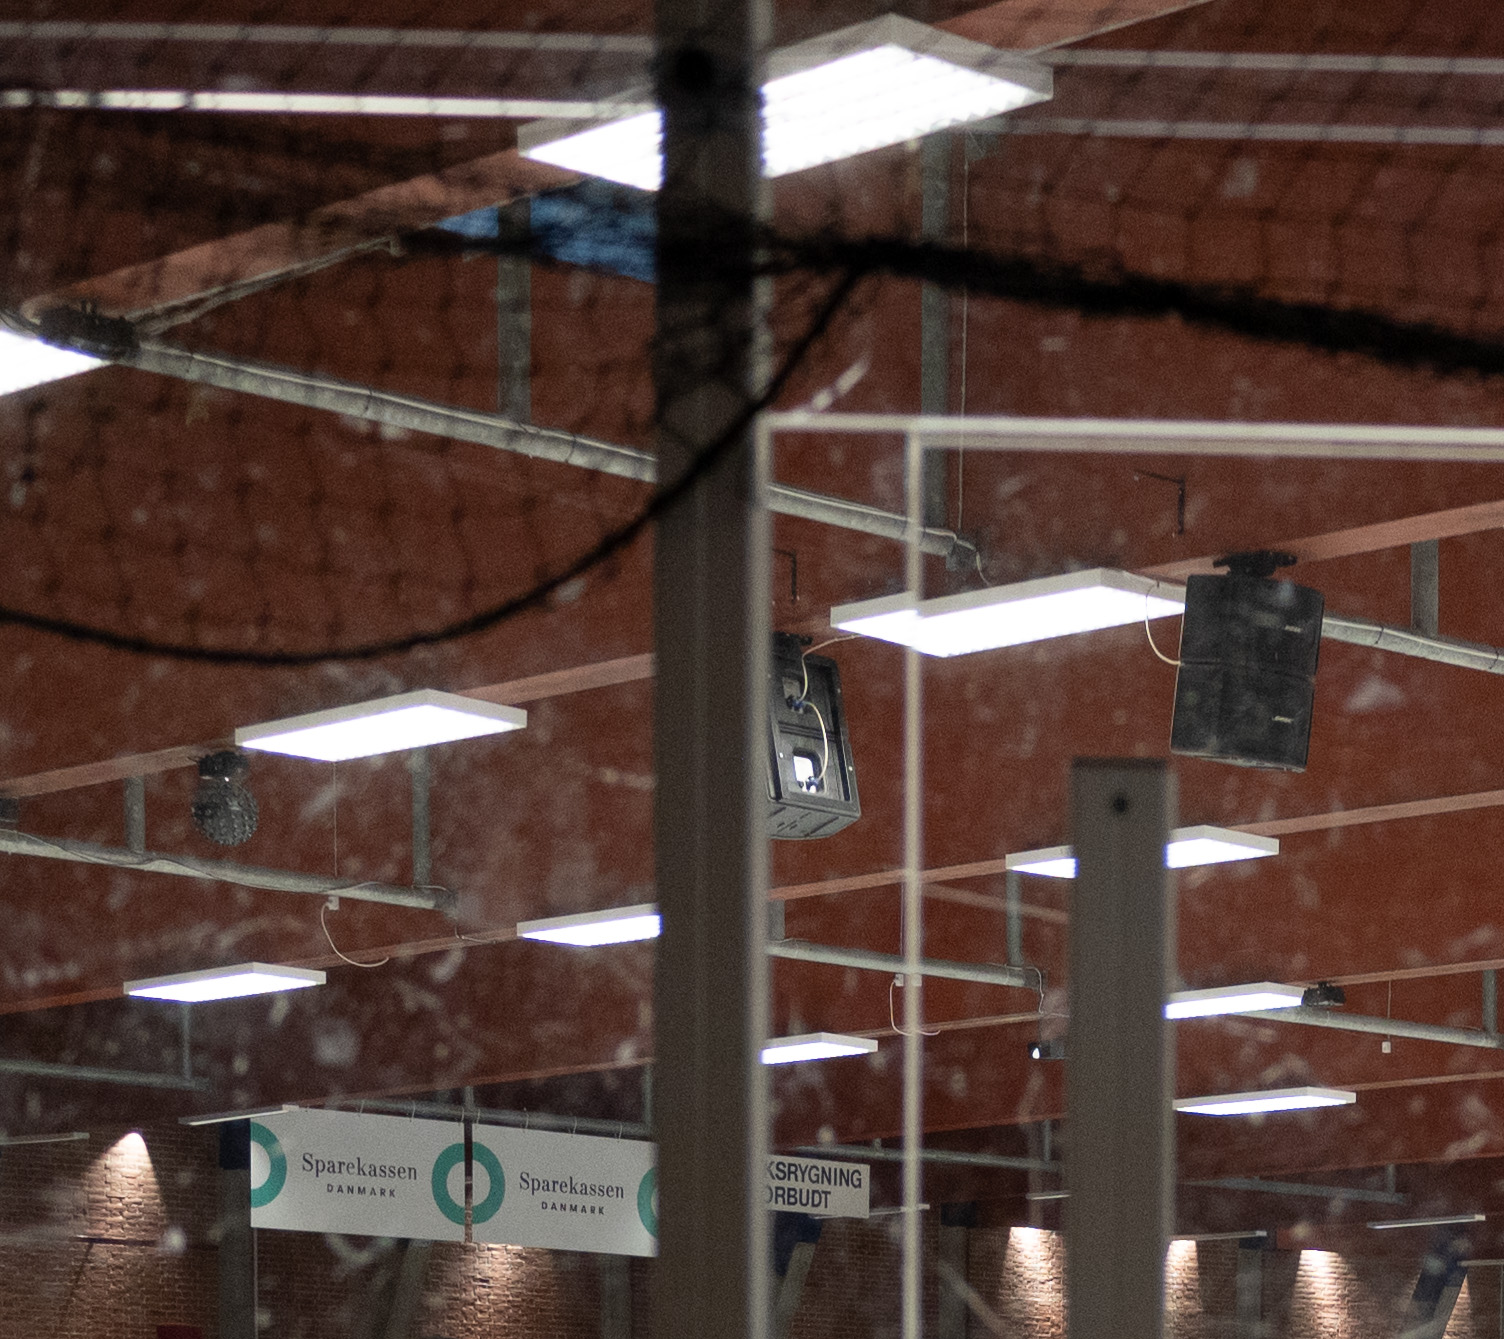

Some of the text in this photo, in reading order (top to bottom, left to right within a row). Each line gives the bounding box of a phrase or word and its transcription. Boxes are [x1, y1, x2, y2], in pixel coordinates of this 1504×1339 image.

[300, 1152, 418, 1184] Sparekassen
[326, 1183, 397, 1199] DANMARK
[518, 1170, 625, 1200] Sparekassen
[540, 1200, 606, 1216] DANMARK
